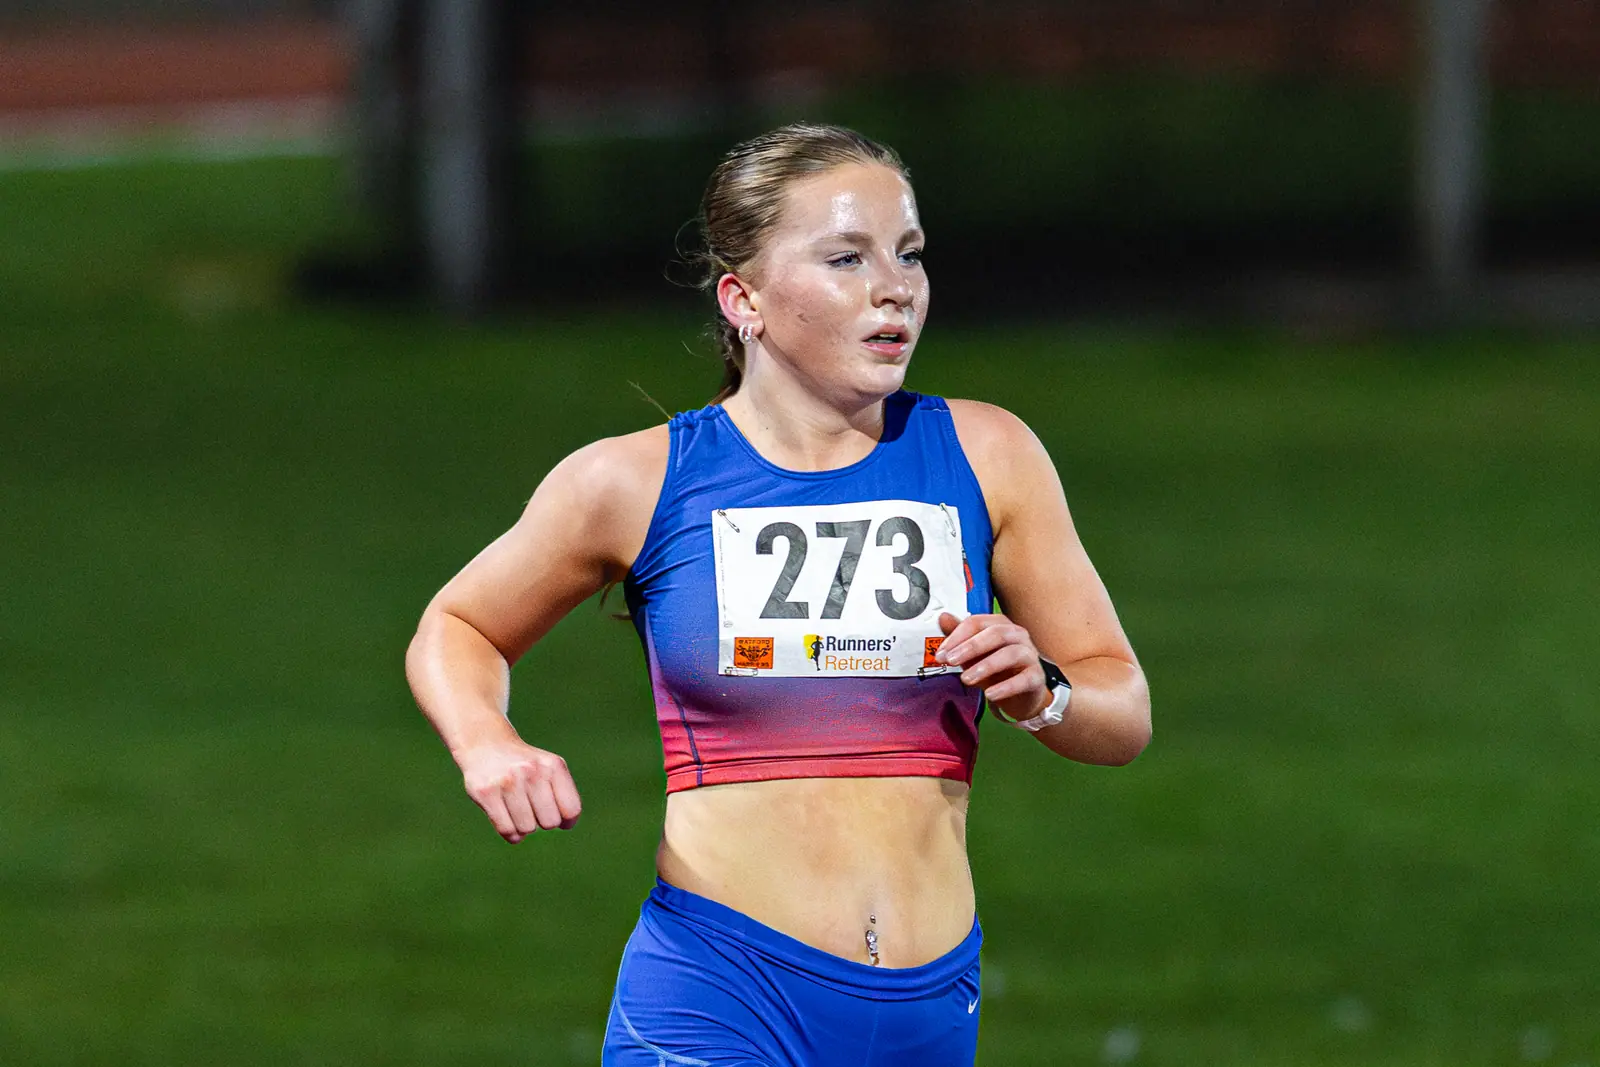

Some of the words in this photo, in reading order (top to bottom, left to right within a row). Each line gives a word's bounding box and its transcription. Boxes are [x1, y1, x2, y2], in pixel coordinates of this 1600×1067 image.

[755, 516, 930, 620] 273
[826, 635, 897, 651] Runners'
[825, 655, 890, 671] Retreat
